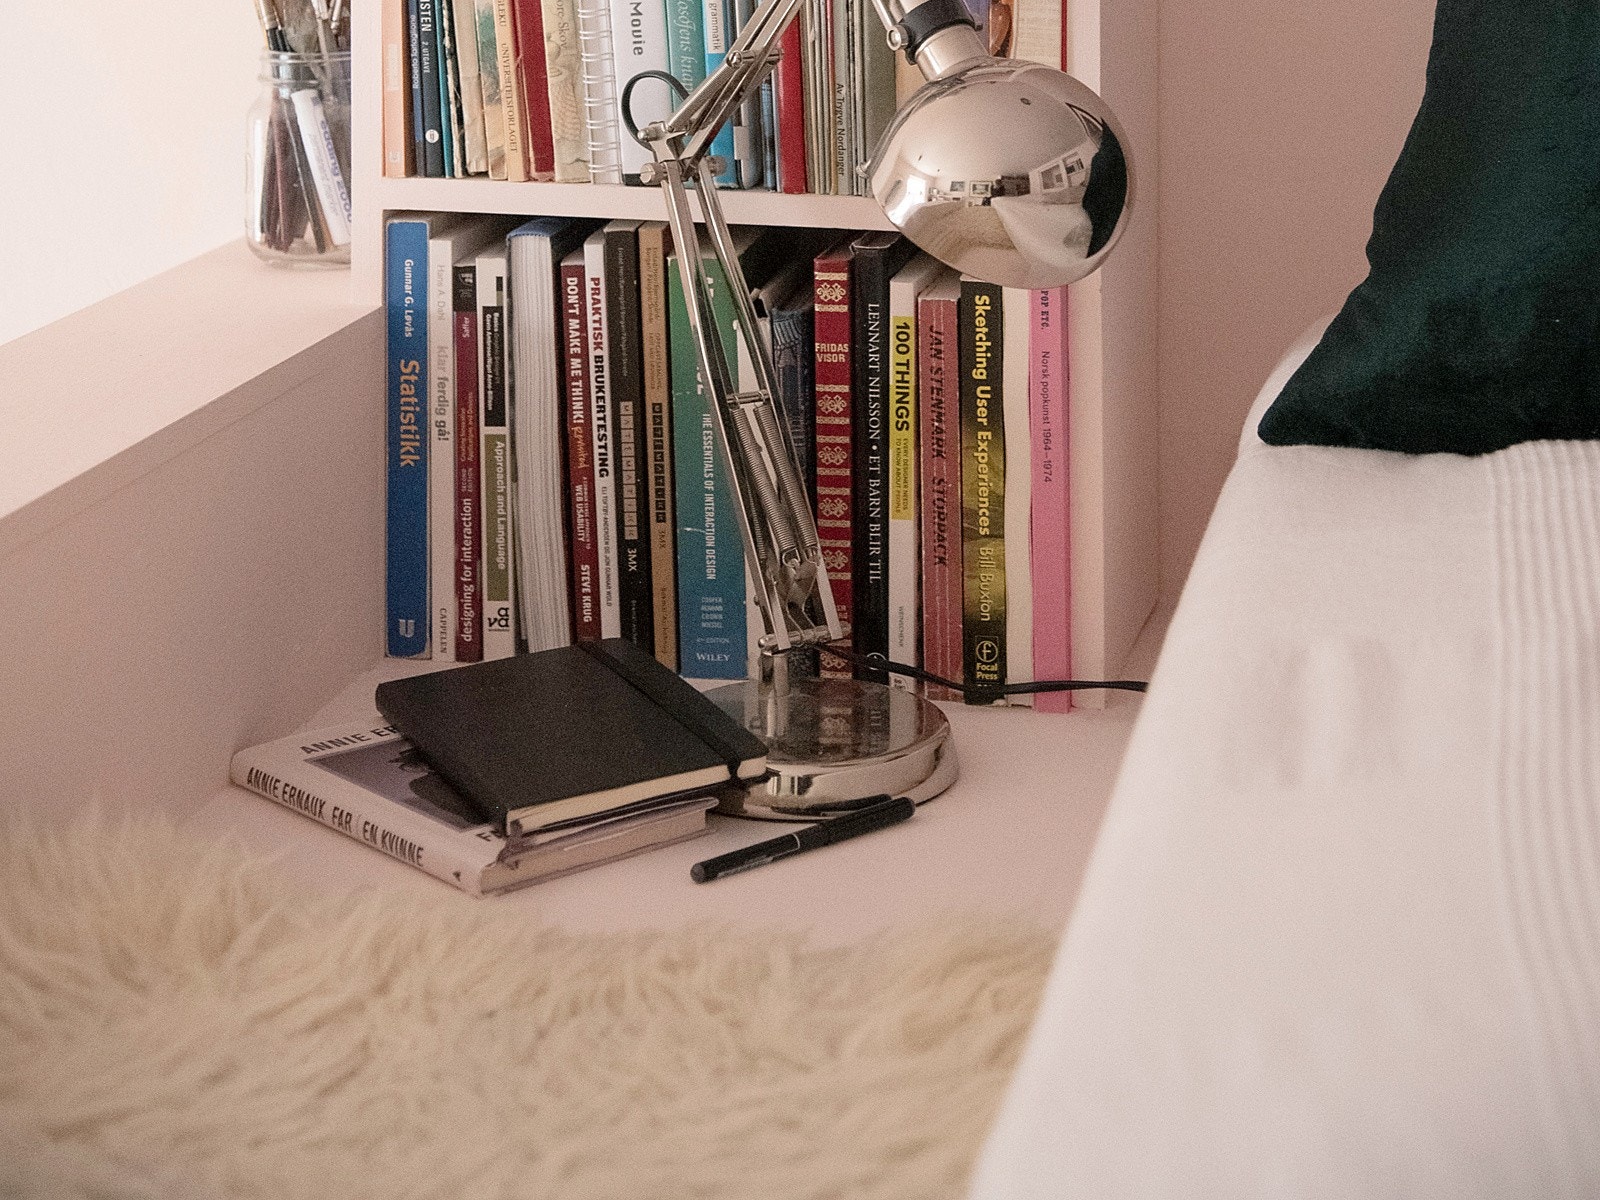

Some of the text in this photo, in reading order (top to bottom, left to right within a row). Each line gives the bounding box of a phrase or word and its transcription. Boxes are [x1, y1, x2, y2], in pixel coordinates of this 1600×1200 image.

[558, 22, 571, 50] Skov
[707, 2, 722, 51] grammatik
[412, 59, 420, 89] Roberto
[422, 49, 431, 74] UTGAVE
[501, 43, 519, 154] UNIVERSITETSFORLAGET
[835, 83, 847, 177] Av Trygve Nordanger
[404, 259, 415, 295] Gunnar
[404, 309, 416, 338] Løvås
[437, 301, 447, 321] Dahl
[462, 316, 470, 339] Saffer
[1040, 290, 1050, 331] POP ETC.
[566, 277, 585, 424] DON'T MAKE ME THINK!
[815, 342, 849, 352] FRIDAS
[816, 353, 846, 363] VISOR
[435, 346, 452, 442] klar ferdig gå!
[590, 277, 610, 479] PRAKTISK BRUKERTESTING
[895, 322, 911, 432] 100 THINGS
[929, 325, 947, 460] JAN STENMARK
[1040, 350, 1051, 425] Norsk popkunst
[399, 359, 421, 467] Statistikk
[703, 430, 715, 478] ESSENTIALS
[868, 303, 881, 584] LENNART NILSSON ET BARN BLIR TIL
[971, 295, 997, 622] Sketching User Experiences Bill Buxton
[495, 440, 507, 571] Approach and Language
[704, 480, 714, 491] OF
[575, 484, 585, 543] WEB USABILITY
[704, 493, 716, 547] INTERACTION
[627, 547, 637, 572] 3MX
[658, 530, 667, 550] 3MX
[459, 498, 476, 642] designing for interaction
[706, 549, 717, 580] DESIGN
[580, 563, 592, 623] STEVE KRUG
[439, 607, 448, 654] CAPPELEN
[696, 652, 730, 661] WILEY
[976, 662, 998, 671] Focal
[976, 671, 998, 680] Press
[299, 731, 367, 756] ANNIE
[246, 765, 425, 868] ANNIE ERNAUX FAR EN KVINNE
